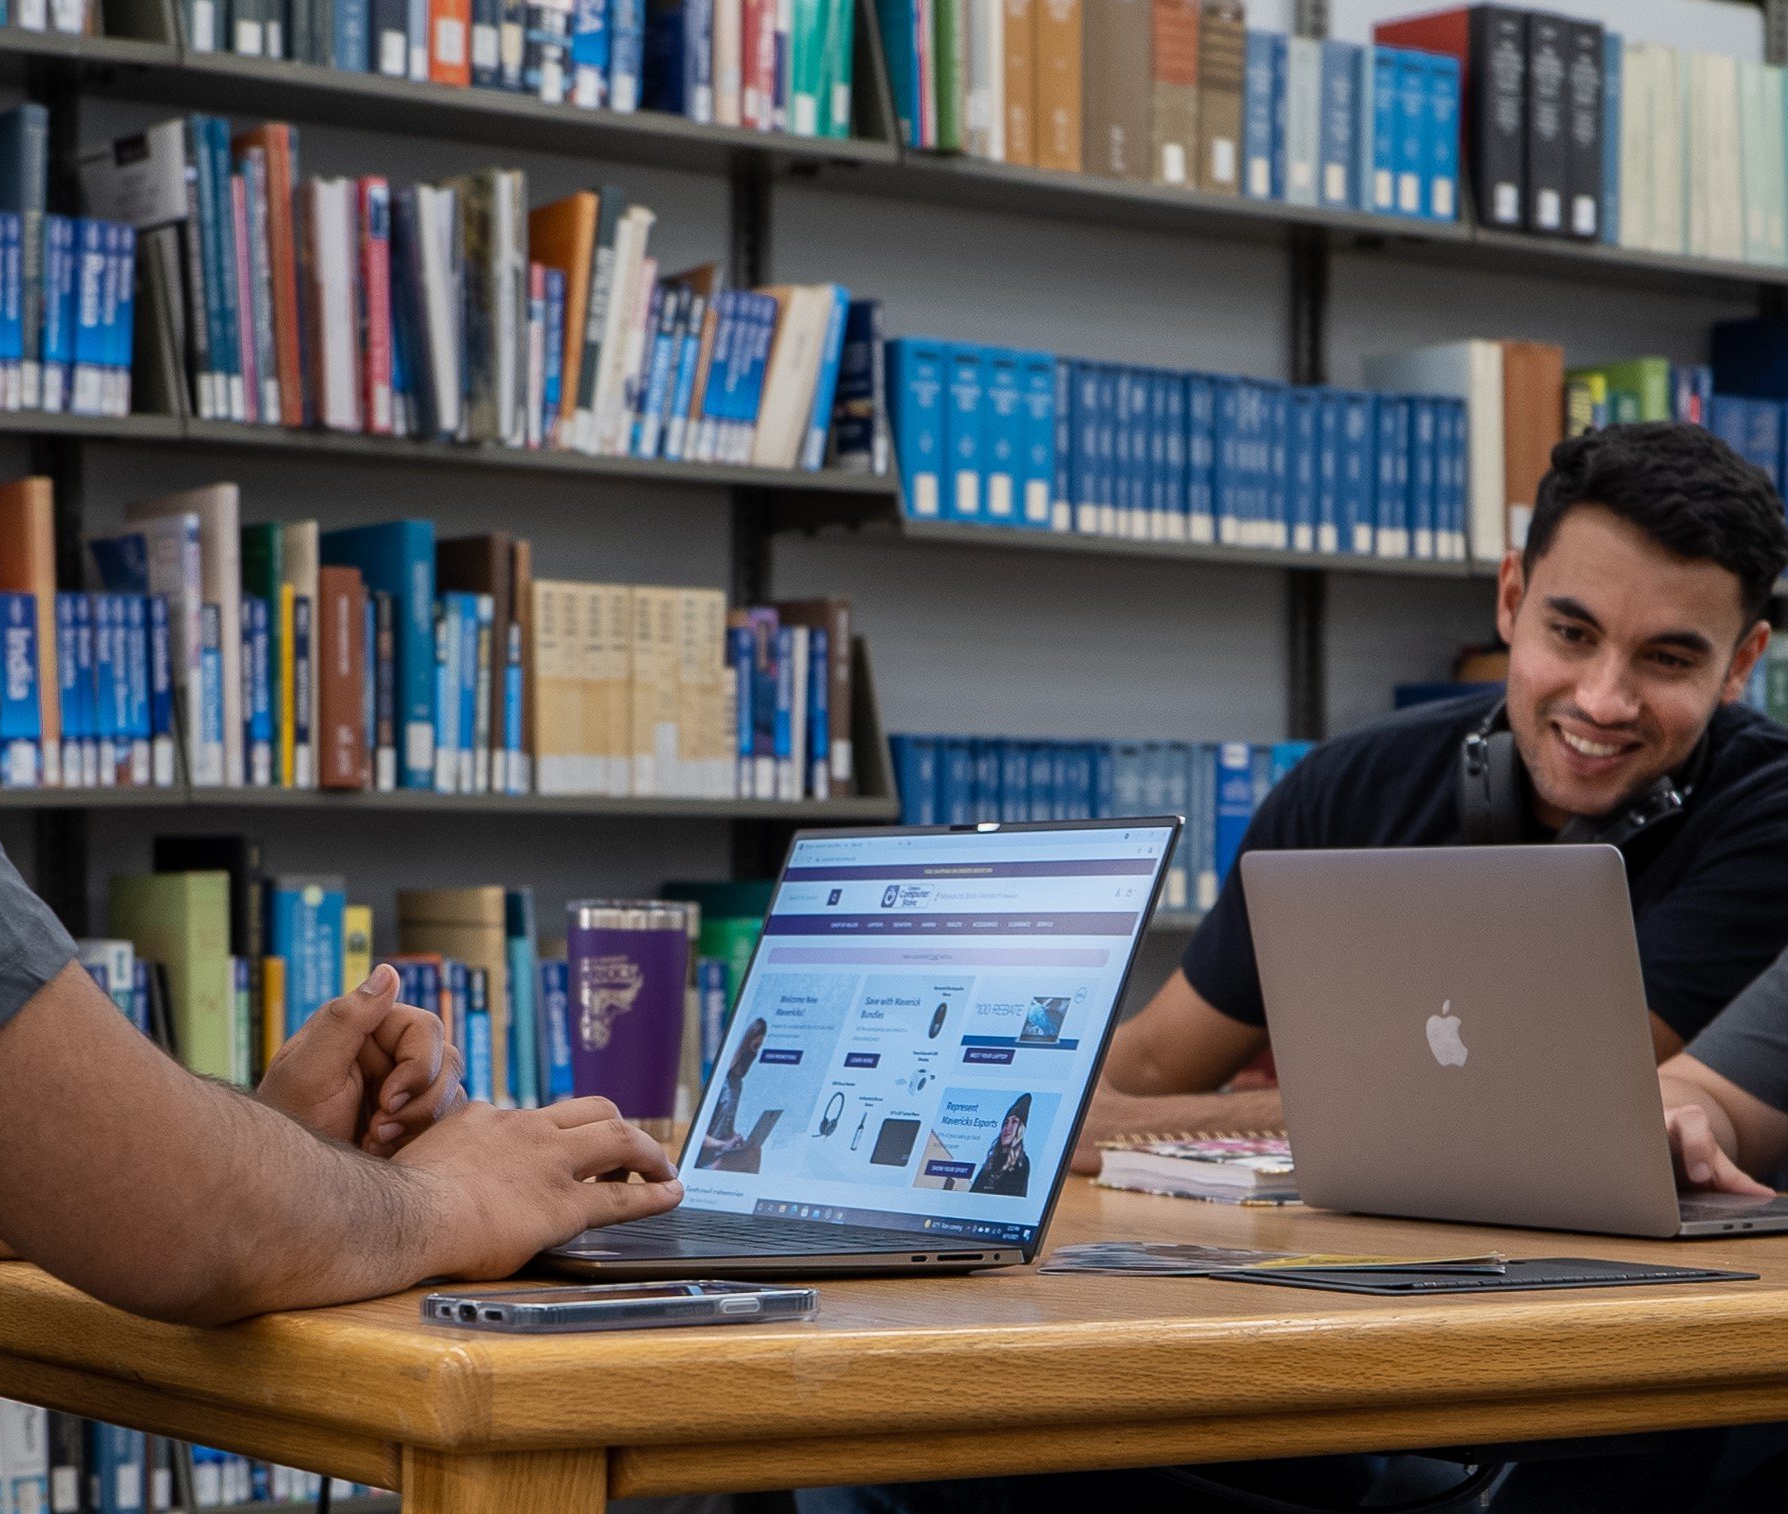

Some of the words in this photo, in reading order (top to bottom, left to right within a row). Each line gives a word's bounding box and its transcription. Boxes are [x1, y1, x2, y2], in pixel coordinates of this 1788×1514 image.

[80, 253, 106, 329] Russia
[5, 626, 33, 700] India
[780, 996, 805, 1004] Welcome
[865, 997, 879, 1006] Save
[880, 997, 894, 1006] with
[895, 998, 921, 1006] Maverick
[860, 1010, 885, 1020] Bundles
[947, 1101, 979, 1113] Represent
[941, 1116, 973, 1126] Mavericks
[973, 1118, 999, 1130] Esports
